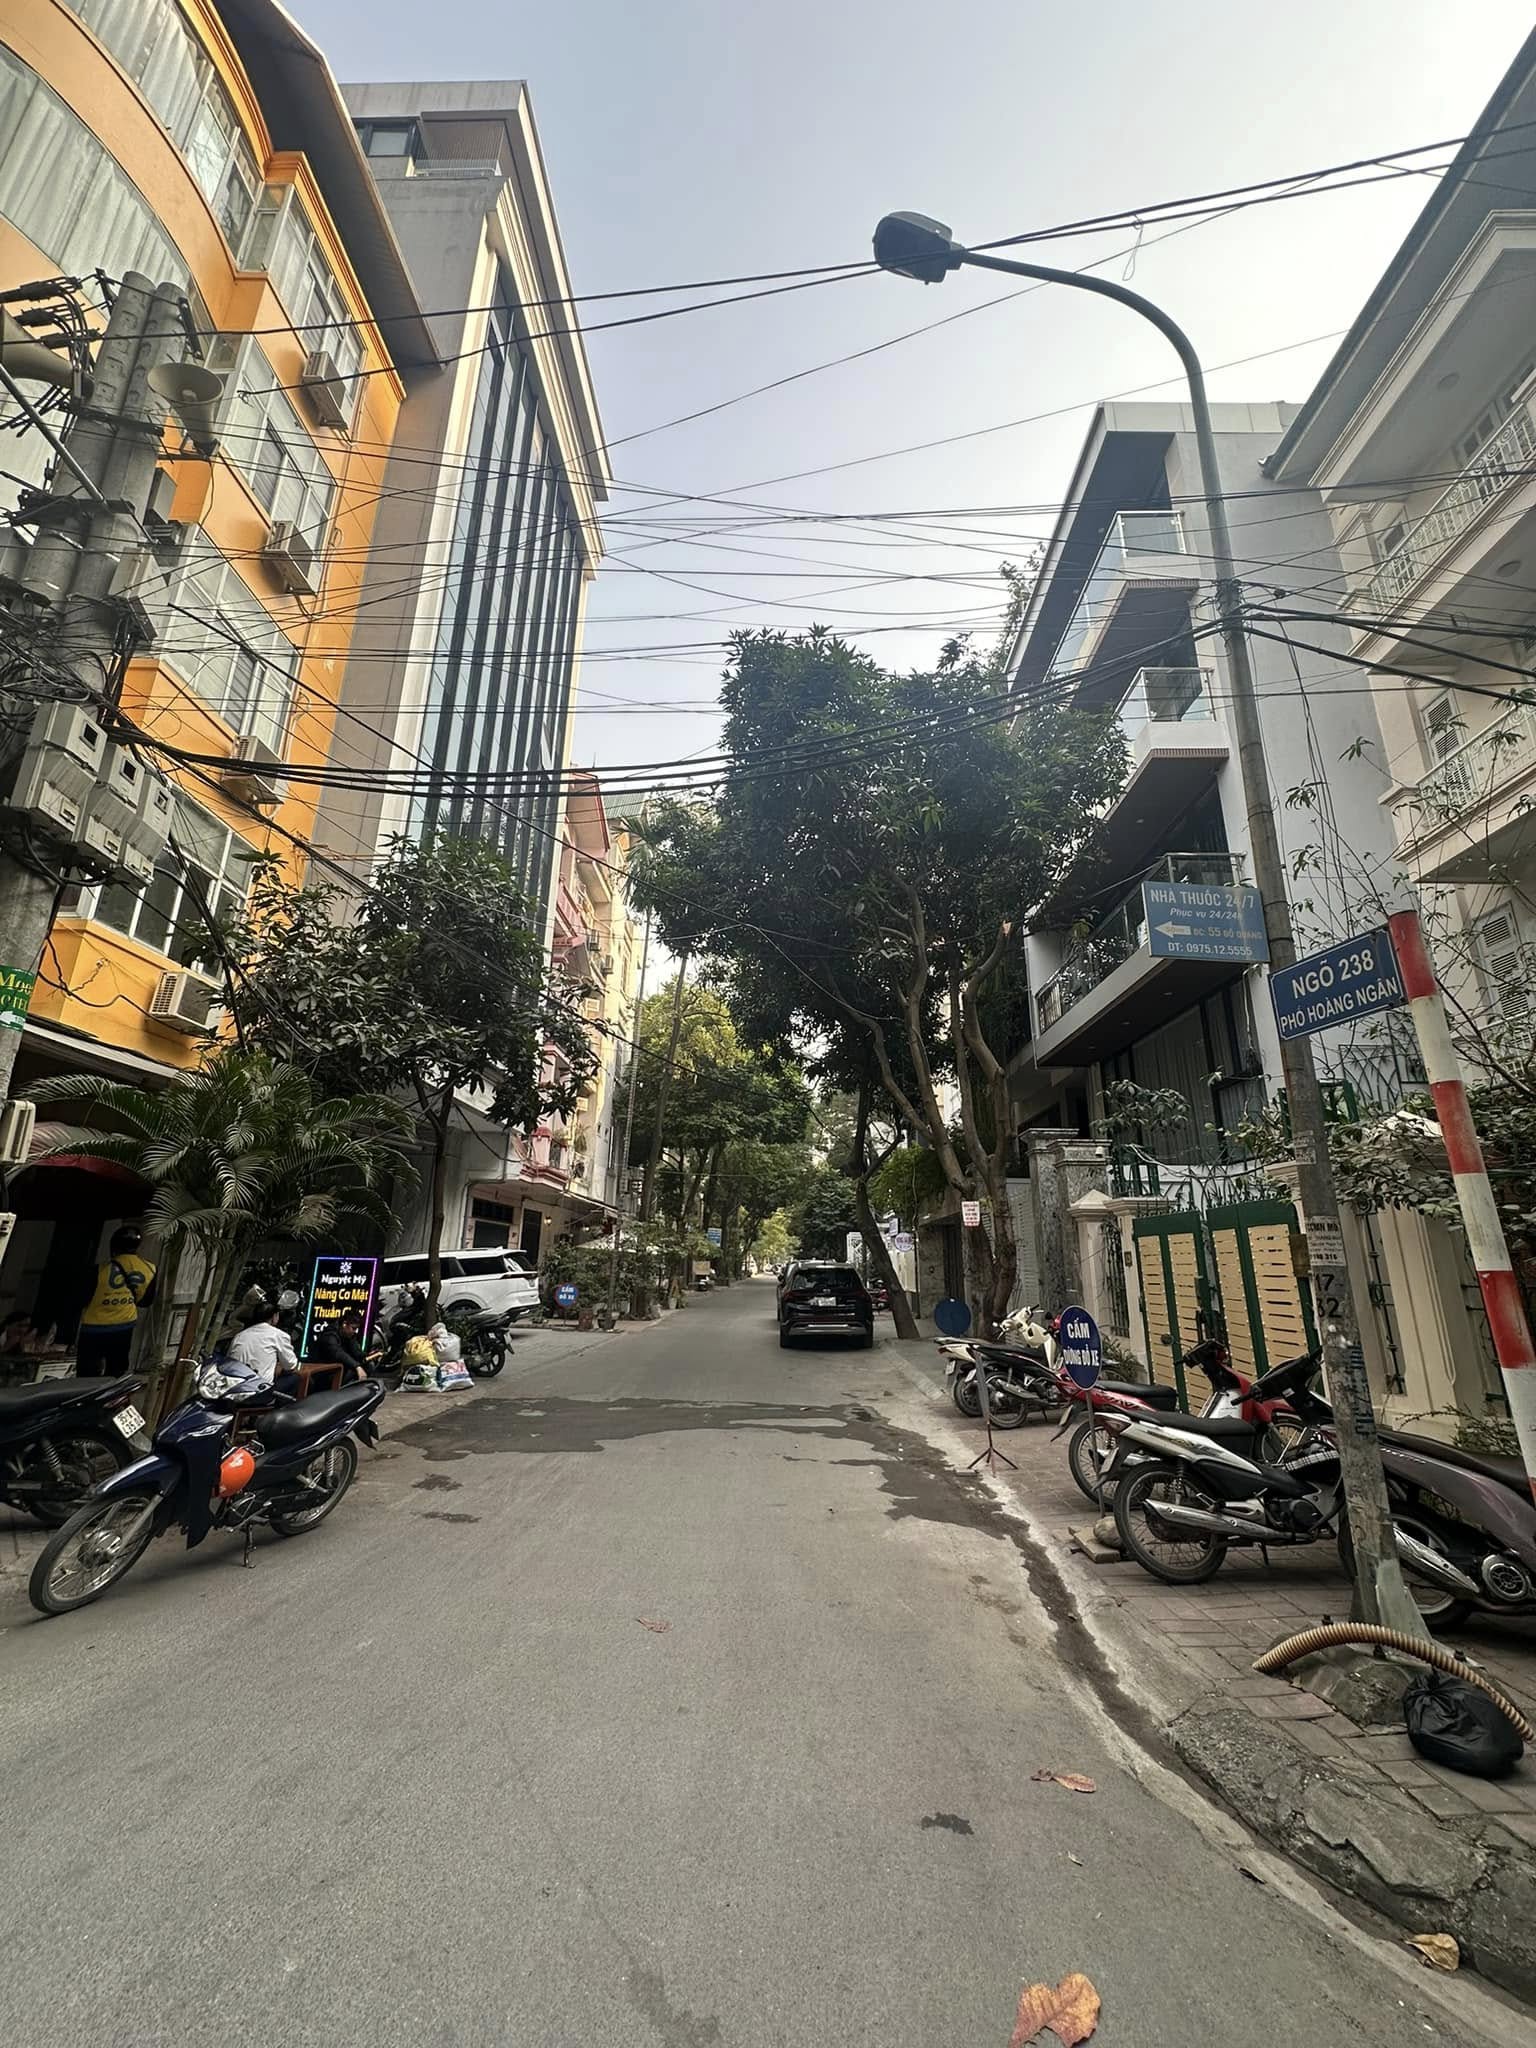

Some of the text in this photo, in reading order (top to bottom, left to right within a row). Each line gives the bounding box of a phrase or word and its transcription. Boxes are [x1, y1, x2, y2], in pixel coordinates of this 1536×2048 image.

[1150, 887, 1176, 903] NHÀ
[1179, 888, 1221, 906] THUỐC
[1207, 926, 1220, 937] 55
[1291, 949, 1374, 999] NGÕ 238
[1307, 996, 1354, 1023] HOÀNG
[1355, 976, 1399, 1006] NGÂN
[1066, 1317, 1091, 1339] CẤM
